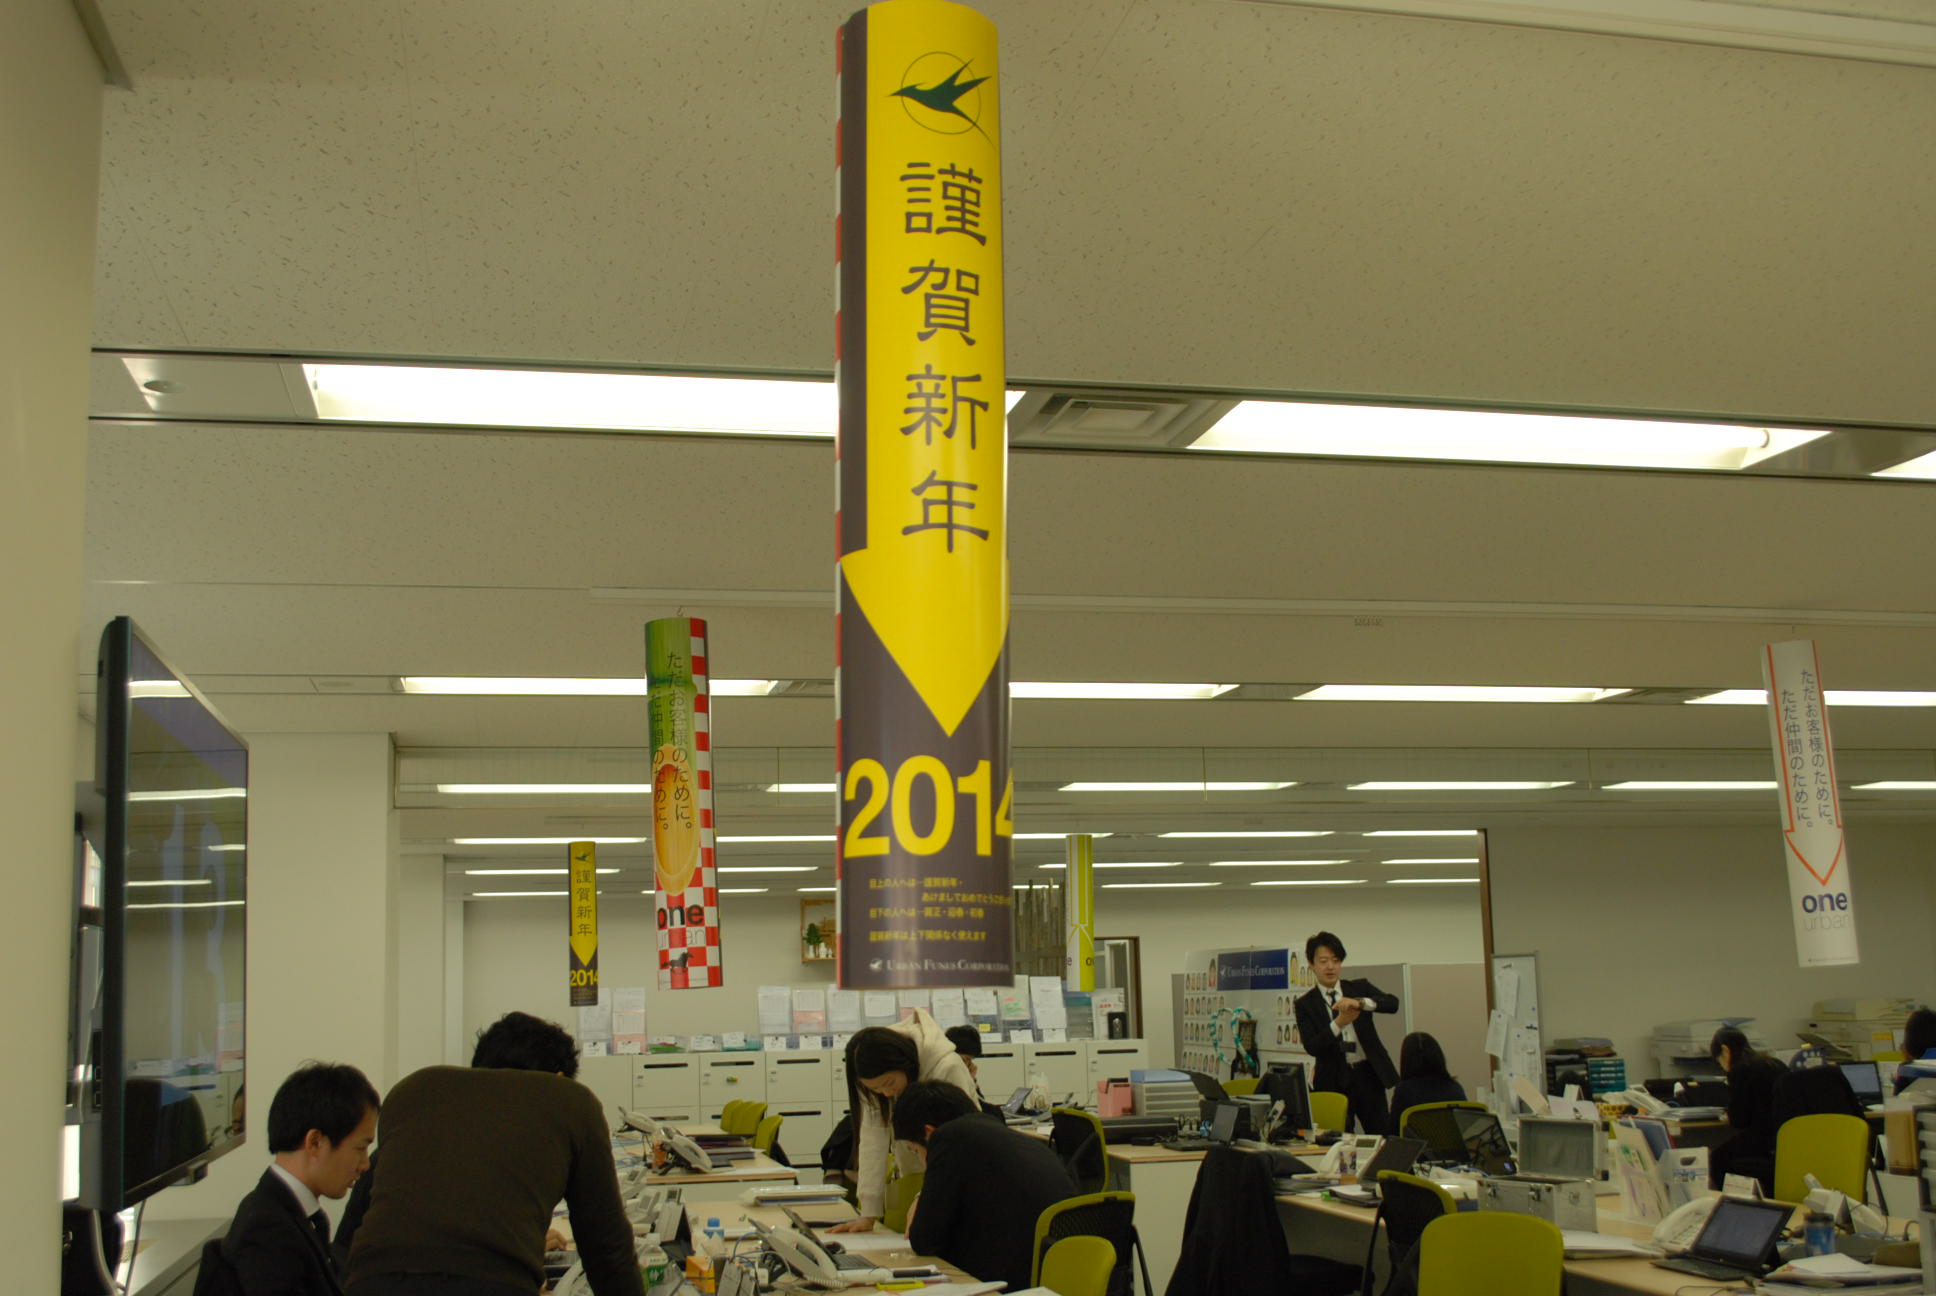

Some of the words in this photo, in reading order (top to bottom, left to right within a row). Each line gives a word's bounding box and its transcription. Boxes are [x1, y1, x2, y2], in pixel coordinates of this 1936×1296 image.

[899, 162, 989, 553] 謹賀新年
[1781, 688, 1814, 828] ただ仲間のために。
[575, 869, 593, 937] 謹賀新年
[657, 904, 705, 929] one
[1802, 892, 1848, 913] one
[570, 968, 598, 987] 2014
